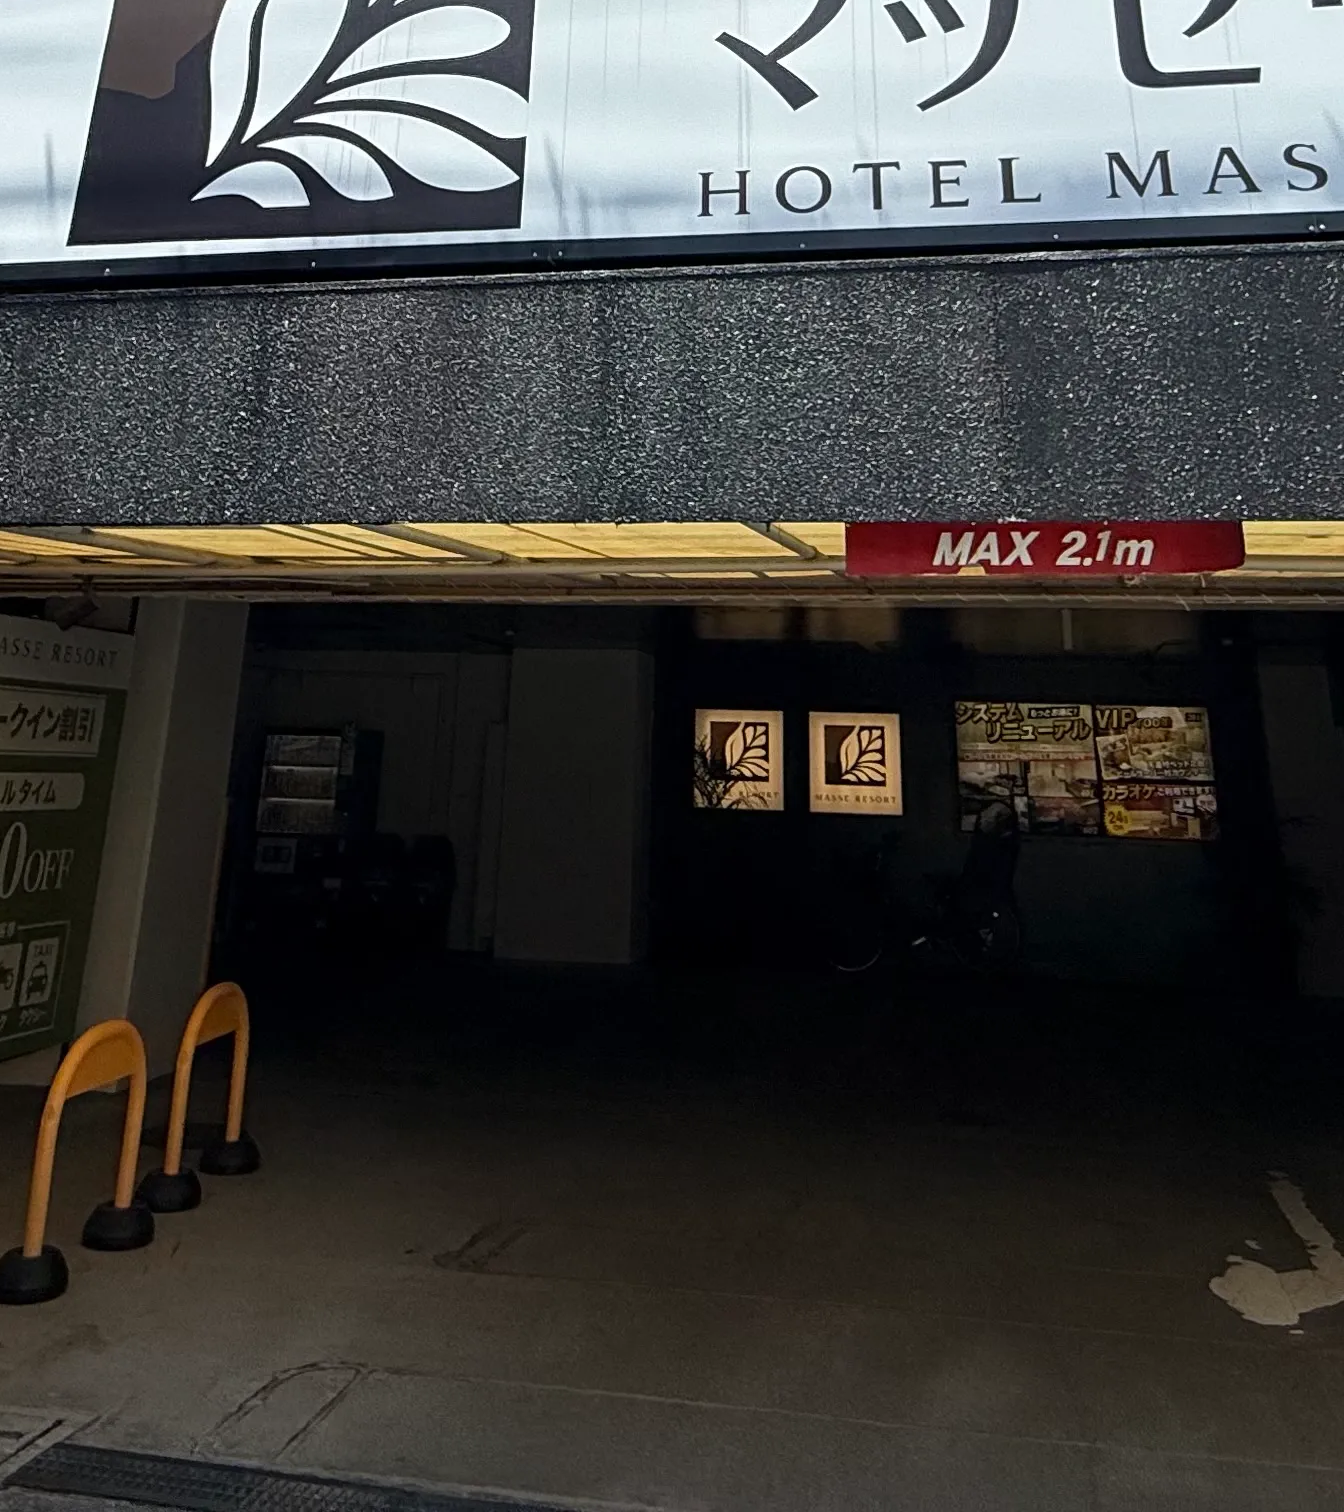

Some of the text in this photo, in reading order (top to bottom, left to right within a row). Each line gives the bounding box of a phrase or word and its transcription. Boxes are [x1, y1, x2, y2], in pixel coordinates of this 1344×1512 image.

[697, 156, 1042, 218] HOTEL
[931, 529, 1155, 567] MAX 2.1m
[51, 643, 119, 669] RESORT
[955, 701, 1024, 725] システム
[1095, 707, 1137, 730] VIP
[986, 718, 1092, 743] リニューアル
[814, 793, 897, 805] MASSE RESORT
[1102, 783, 1157, 802] カラオケ
